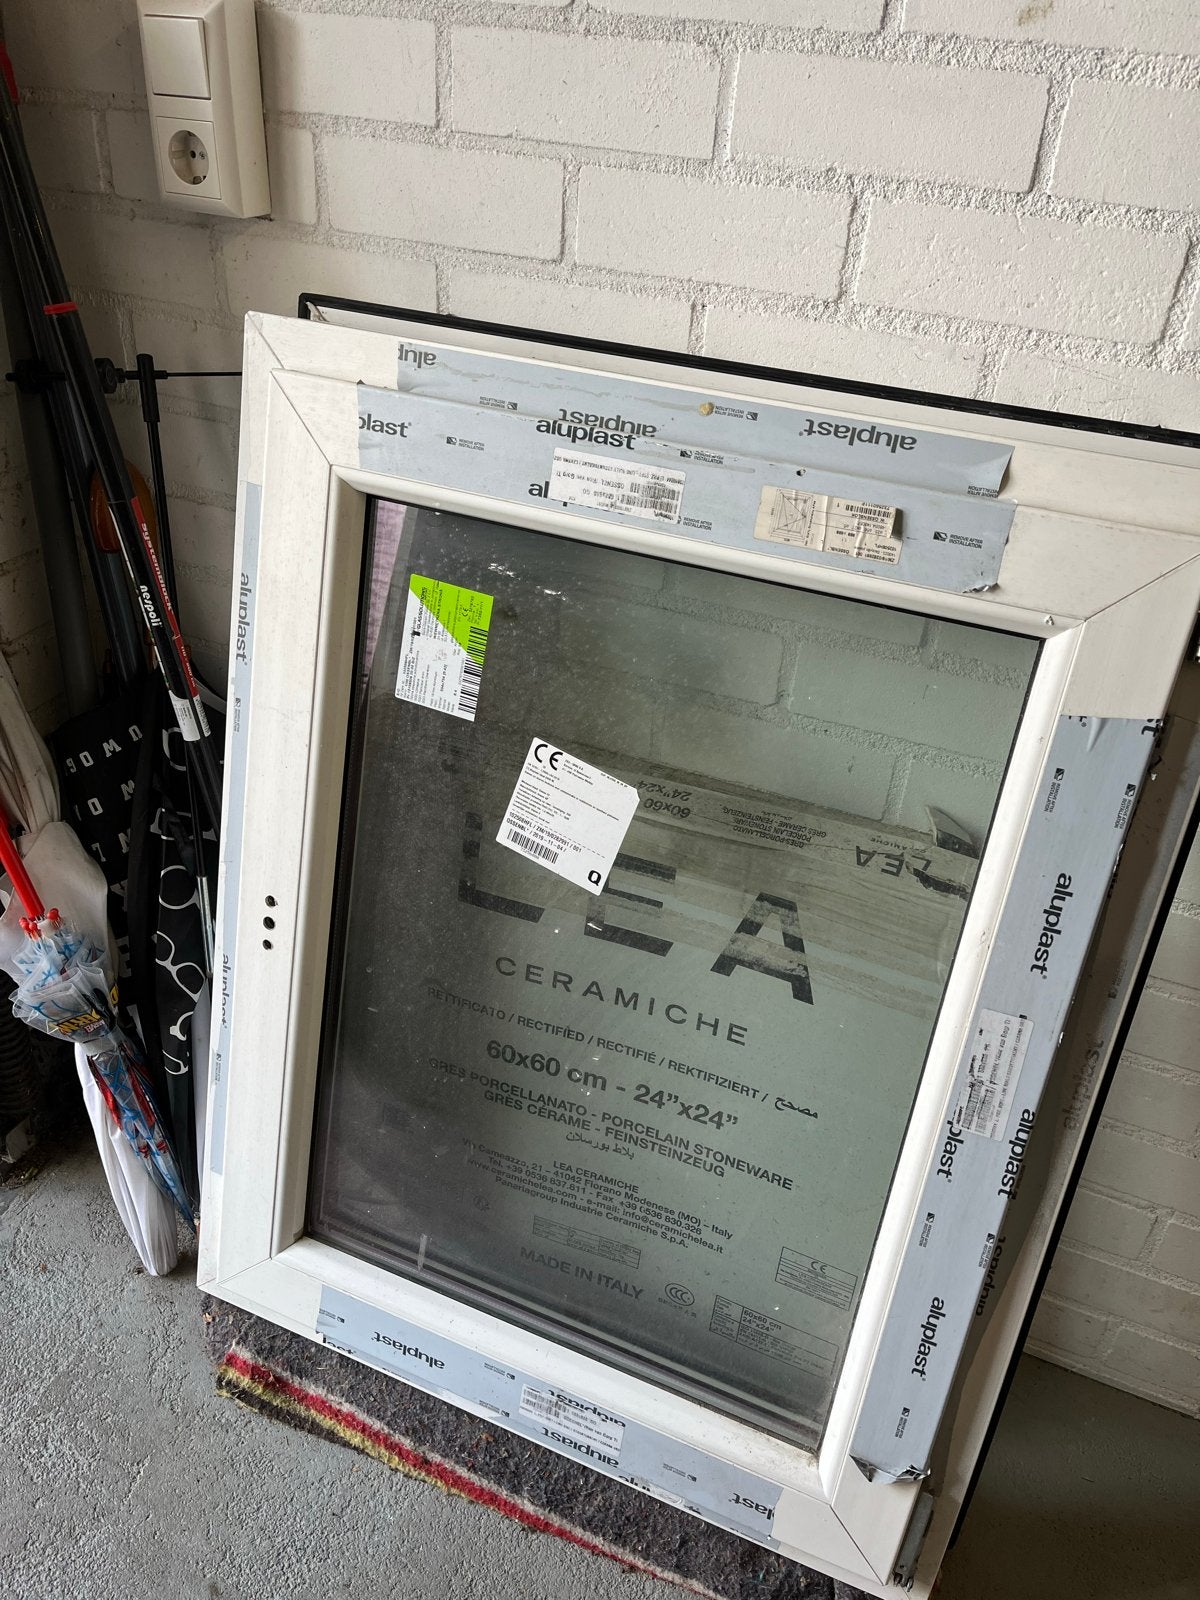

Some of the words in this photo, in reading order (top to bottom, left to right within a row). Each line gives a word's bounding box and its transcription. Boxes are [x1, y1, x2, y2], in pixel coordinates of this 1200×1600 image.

[398, 344, 437, 369] alu
[536, 418, 636, 450] aluplast
[804, 418, 918, 454] aluplast
[139, 585, 162, 627] nespoli
[235, 572, 252, 662] aluplast
[643, 798, 691, 819] 60x60
[1044, 782, 1056, 812] INSTALLATION
[588, 870, 601, 886] Q
[1031, 872, 1073, 975] aluplast
[495, 956, 749, 1047] CERAMICHE
[427, 986, 506, 1020] RETTIFICATO
[517, 1015, 585, 1042] RECTIFIED
[597, 1037, 657, 1064] RECTIFIÉ
[668, 1059, 760, 1099] REKTIFIZIERT
[486, 1040, 561, 1077] 60x60
[567, 1067, 607, 1091] cm
[429, 1057, 466, 1078] GRES
[470, 1071, 588, 1116] PORCELLANATO
[601, 1112, 690, 1150] PORCELAIN
[694, 1143, 794, 1190] STONEWARE
[527, 1101, 592, 1131] CÉRAME
[605, 1126, 725, 1178] FEINSTEINZEUG
[937, 1119, 964, 1178] plast
[553, 1160, 573, 1174] LEA
[576, 1167, 640, 1194] CERAMICHE
[998, 1108, 1035, 1200] aluplast
[495, 1175, 558, 1204] Panariagroup
[560, 1198, 603, 1217] Industrie
[606, 1212, 658, 1236] Ceramiche
[660, 1230, 688, 1248] S.p.A.
[506, 1164, 523, 1175] +39
[525, 1169, 548, 1182] 0536
[620, 1200, 637, 1212] +39
[664, 1214, 702, 1236] 830.326
[531, 1162, 542, 1172] 21
[553, 1169, 582, 1184] 41042
[584, 1178, 622, 1197] Fiorano
[624, 1192, 676, 1216] Modenese
[678, 1210, 701, 1228] (MO)
[712, 1224, 734, 1240] Italy
[586, 1197, 620, 1214] e-mail:
[622, 1210, 724, 1254] info@ceramichelea.it
[520, 1247, 572, 1274] MADE
[574, 1266, 594, 1282] IN
[597, 1274, 644, 1300] ITALY
[743, 1310, 768, 1324] 60x60
[911, 1296, 946, 1378] aluplast
[374, 1332, 446, 1370] aluplast
[542, 1427, 619, 1468] aluplast
[731, 1492, 775, 1520] last
